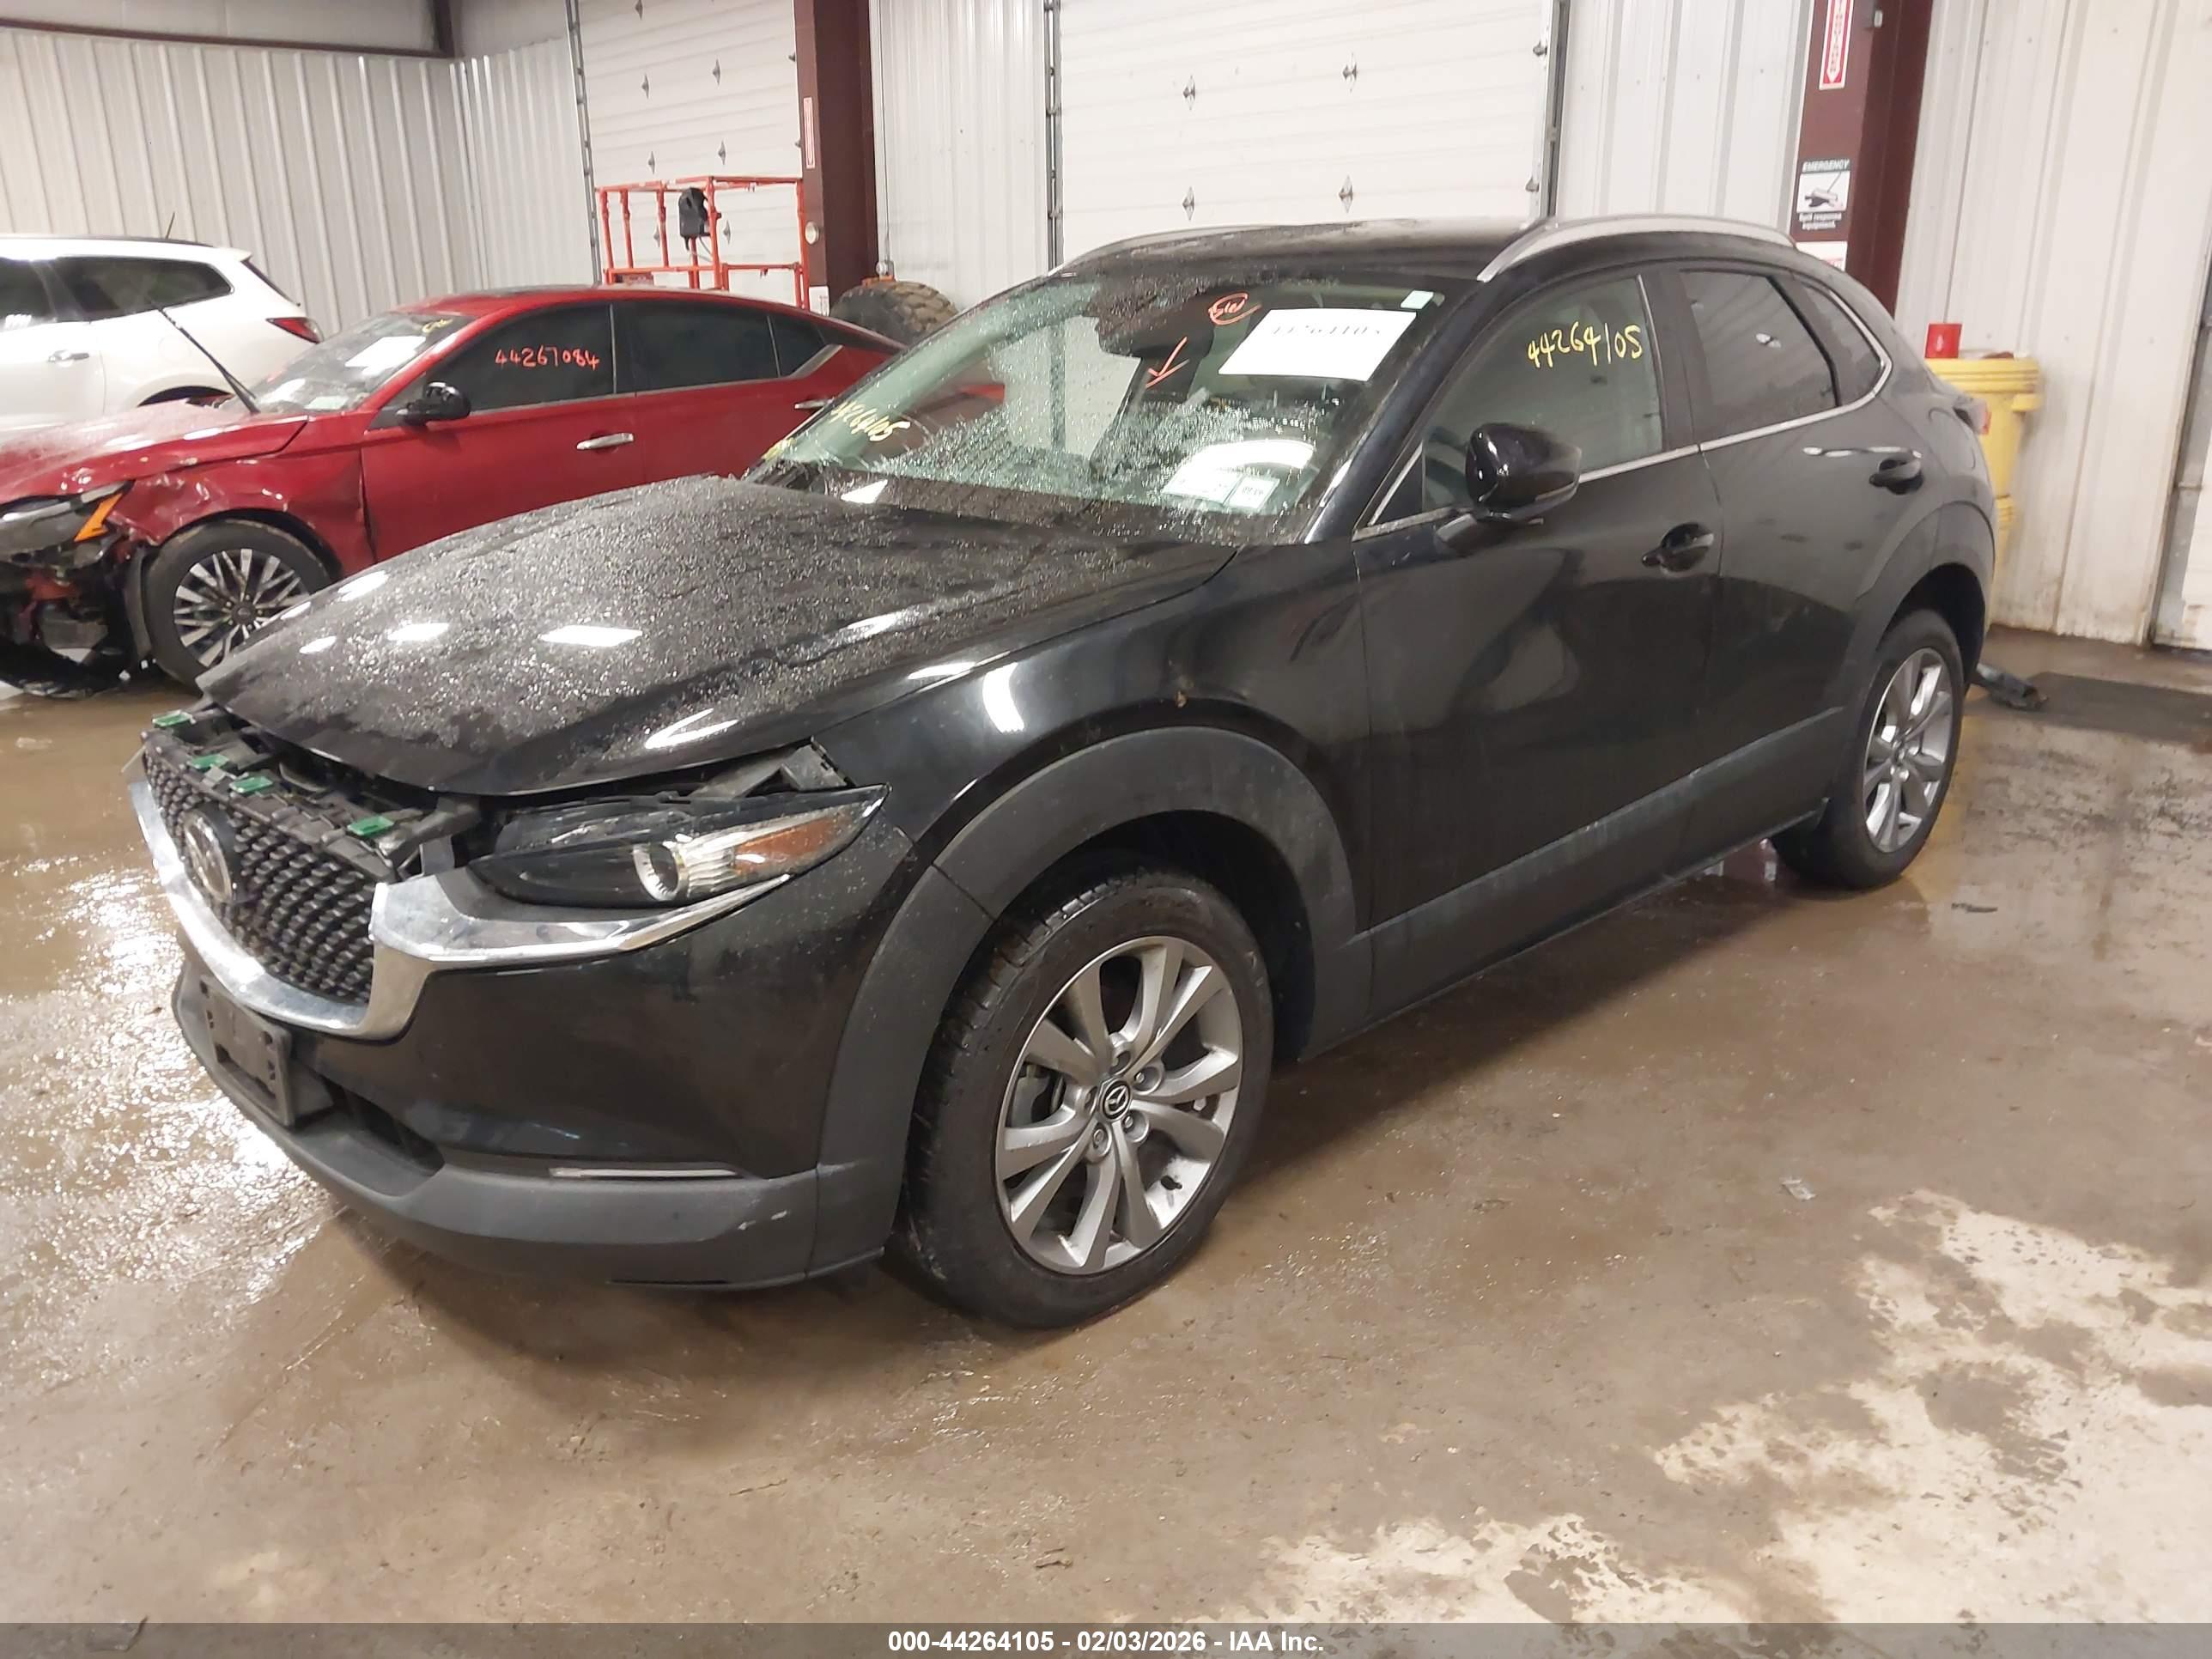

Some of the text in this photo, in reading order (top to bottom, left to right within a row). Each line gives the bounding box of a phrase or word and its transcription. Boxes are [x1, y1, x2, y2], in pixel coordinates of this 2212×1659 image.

[1802, 159, 1850, 172] EMERGENCY
[1528, 321, 1642, 368] 44264105
[495, 345, 600, 370] 44267084
